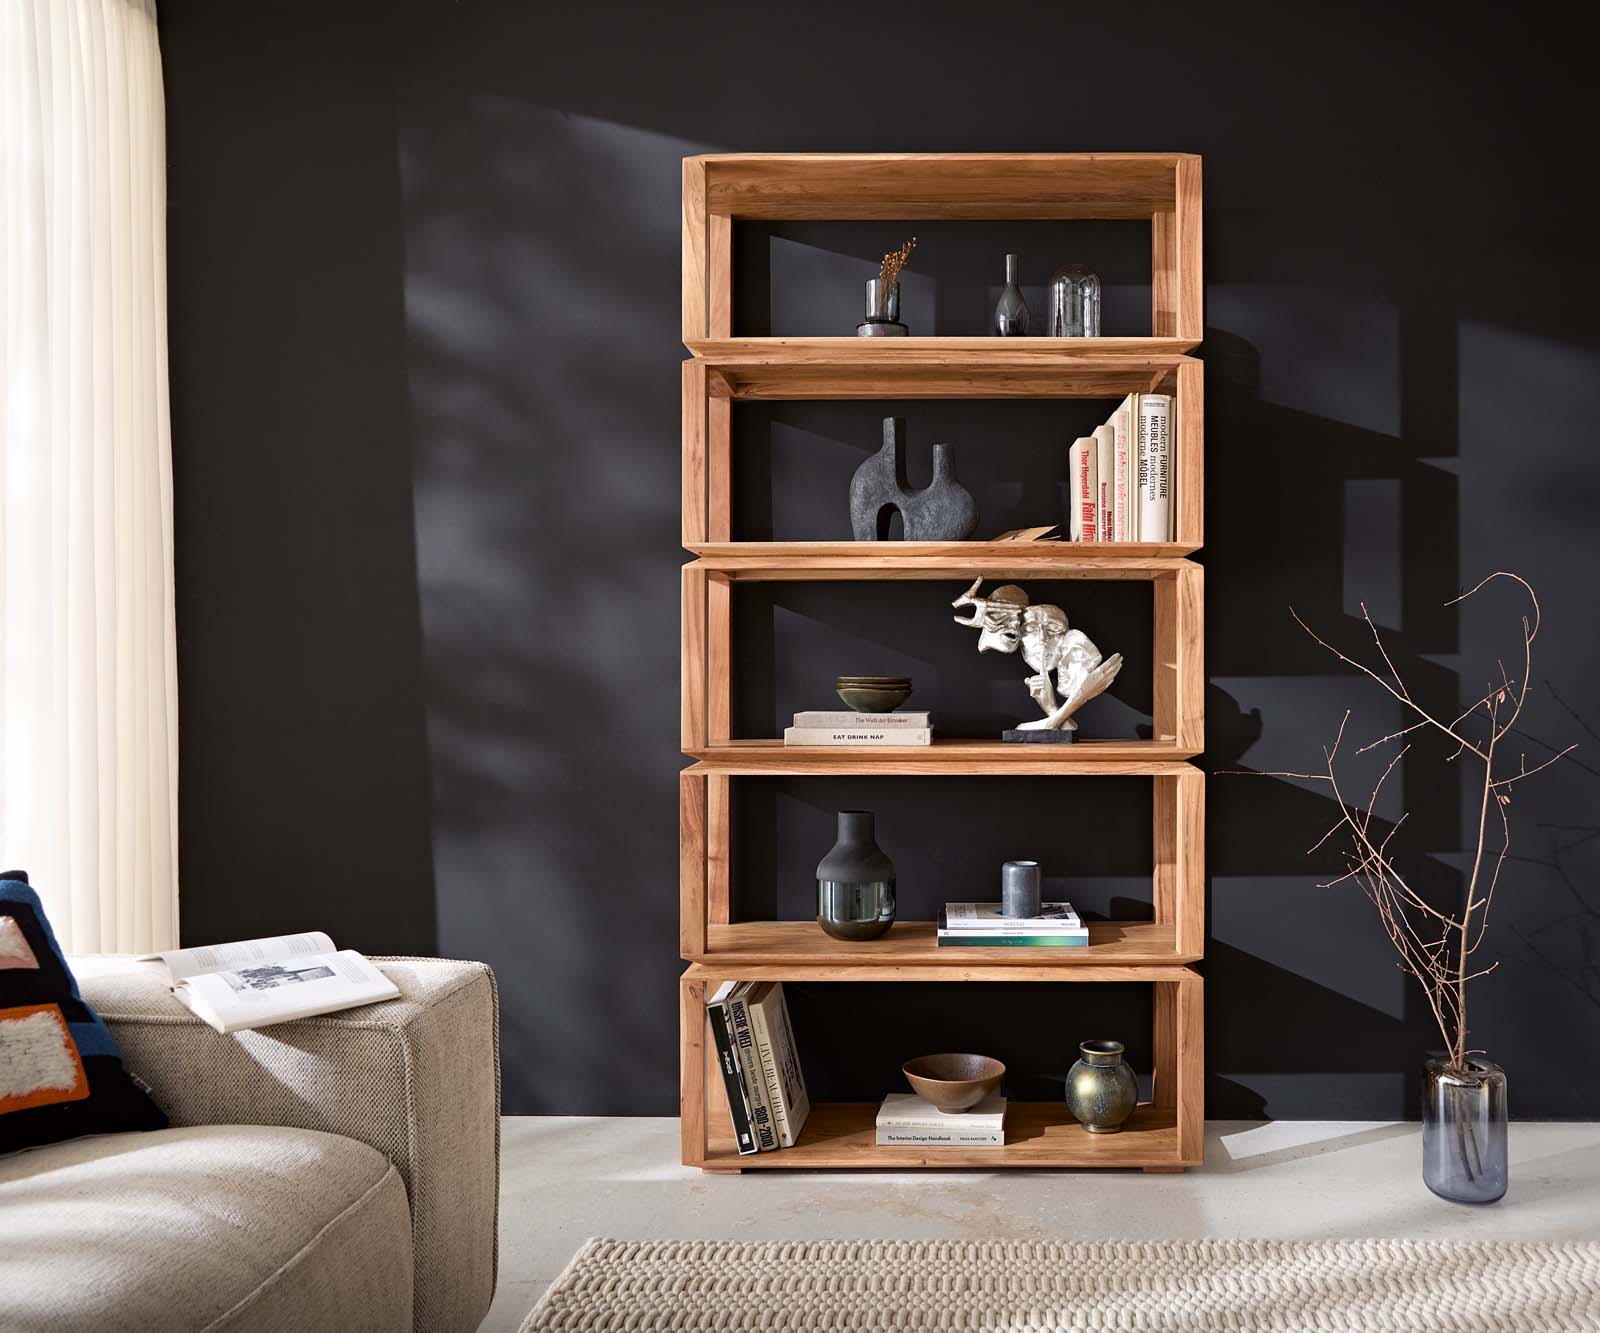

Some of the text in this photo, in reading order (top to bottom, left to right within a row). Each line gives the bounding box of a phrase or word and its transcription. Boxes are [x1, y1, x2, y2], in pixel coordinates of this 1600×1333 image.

[1139, 416, 1149, 488] moderne MÖBEL
[1150, 416, 1159, 453] MEUBLES
[1081, 450, 1089, 466] Thor
[1081, 466, 1090, 499] Heyerdahl
[1150, 455, 1159, 501] modernes
[1160, 454, 1168, 499] FURNITURE
[1082, 502, 1096, 522] Fatu
[731, 1001, 747, 1030] UNSERE
[738, 1027, 753, 1049] WELT
[760, 1042, 773, 1067] LIVE
[765, 1067, 785, 1122] BEAUTIFUL
[754, 1105, 774, 1148] 1800-2000
